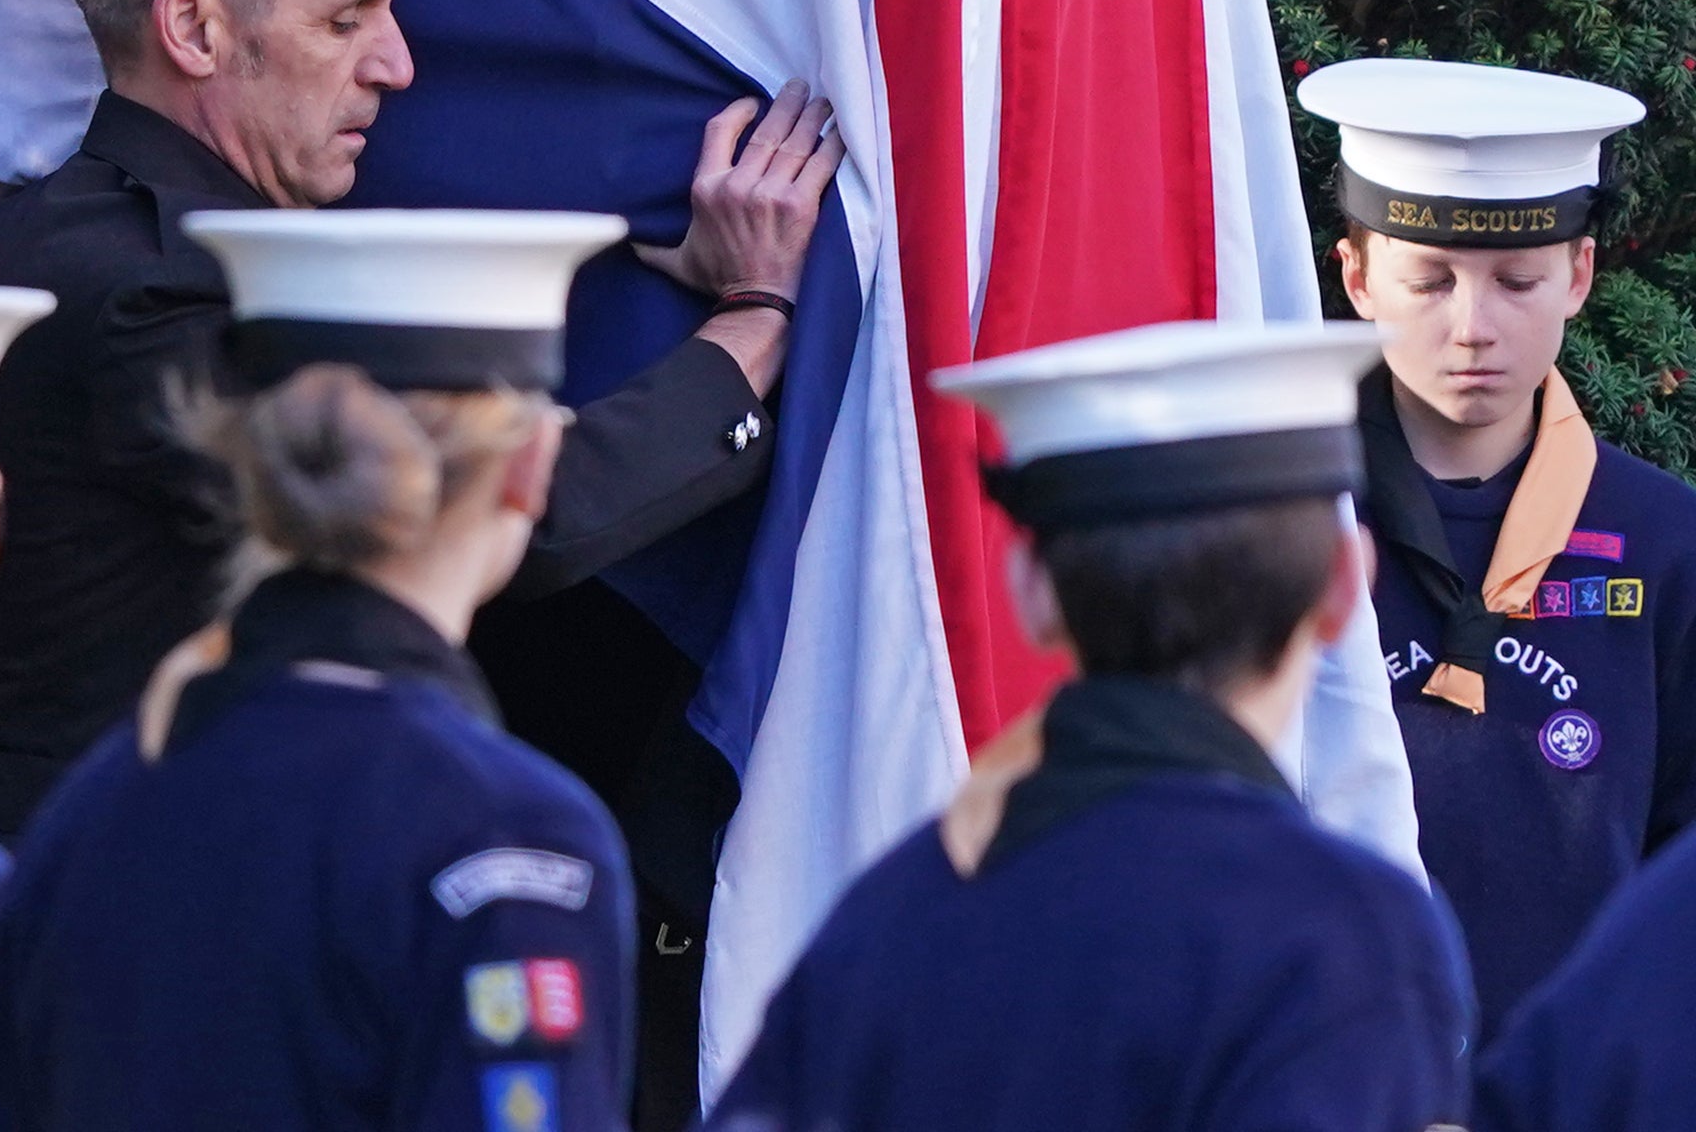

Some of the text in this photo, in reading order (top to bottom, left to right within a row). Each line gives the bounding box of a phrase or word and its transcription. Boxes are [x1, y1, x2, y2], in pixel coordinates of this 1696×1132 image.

[1386, 199, 1557, 232] SEA SCOUTS
[1384, 636, 1578, 701] EA OUTS
